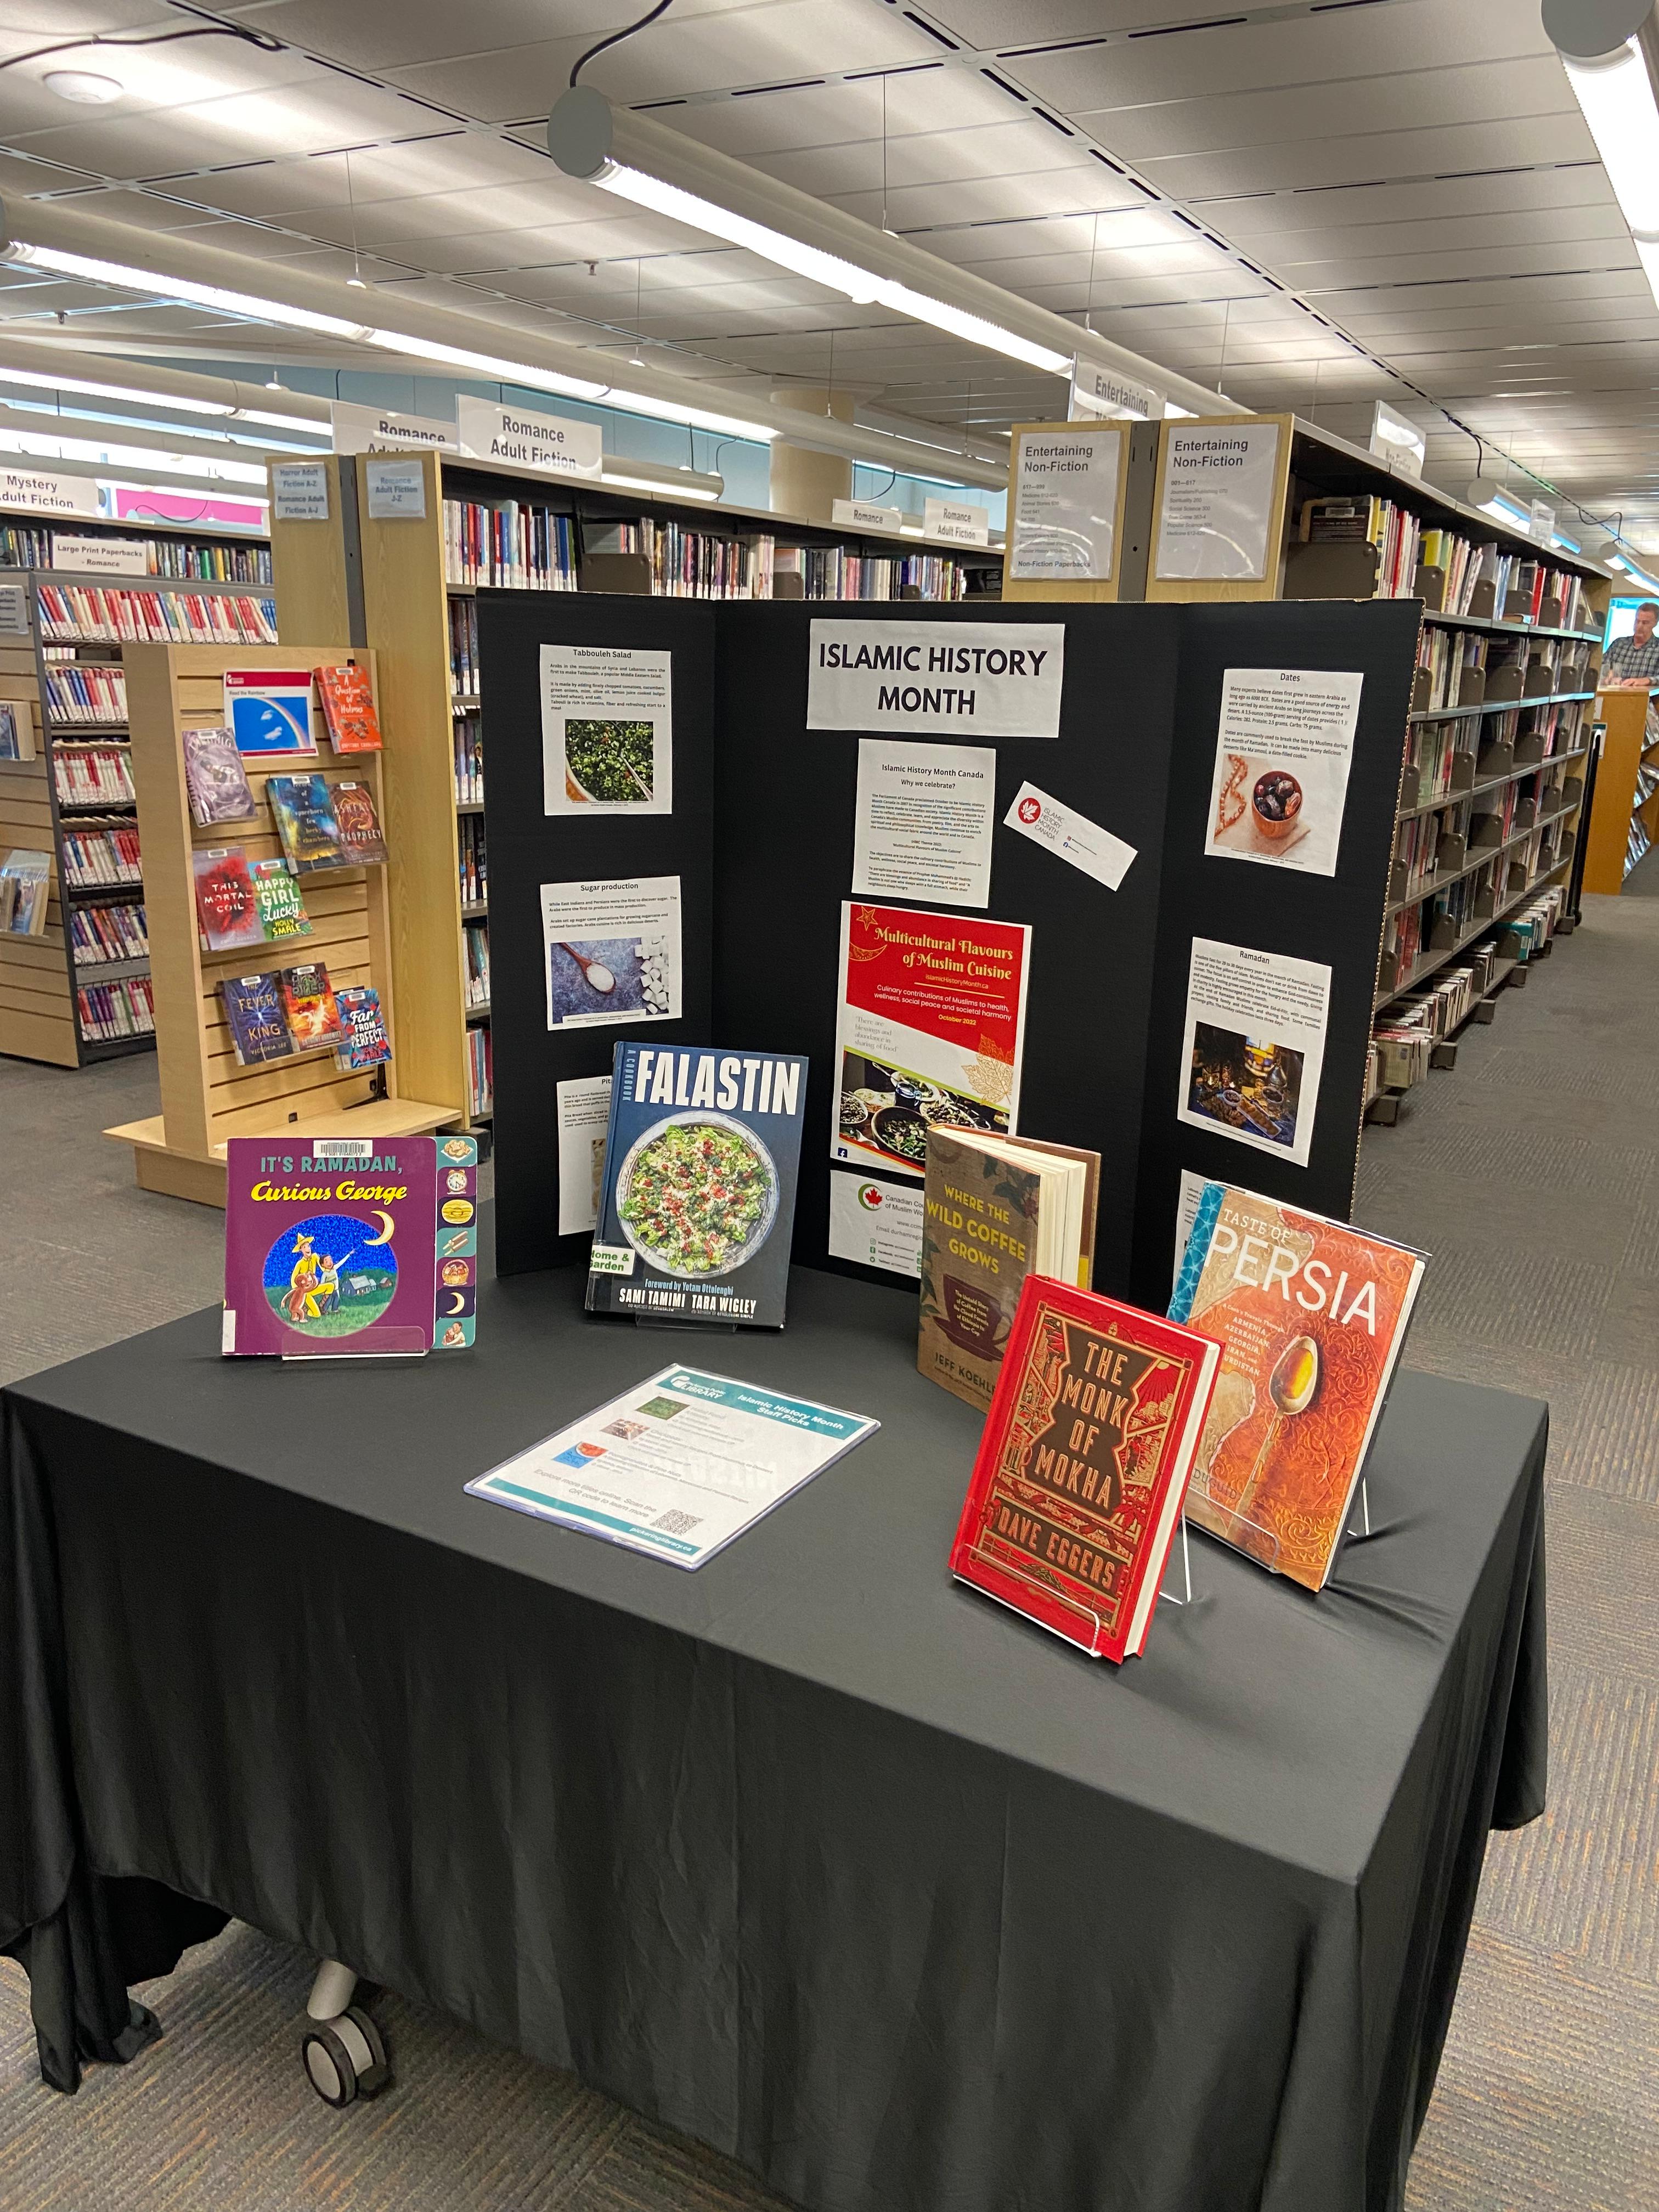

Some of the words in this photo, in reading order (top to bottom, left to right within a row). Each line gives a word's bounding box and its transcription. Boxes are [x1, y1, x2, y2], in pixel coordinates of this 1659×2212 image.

[1096, 374, 1148, 417] Entertaining
[379, 420, 445, 444] Romance
[502, 415, 565, 443] Romance
[490, 439, 527, 460] Adult
[532, 447, 577, 470] Fiction
[1025, 445, 1093, 460] Entertaining
[1174, 439, 1249, 454] Entertaining
[1024, 461, 1089, 472] Non-Fiction
[1173, 456, 1243, 468] Non-Fiction
[7, 475, 58, 493] Mystery
[0, 492, 27, 503] dult
[31, 494, 74, 509] Fiction
[854, 509, 883, 524] Romance
[943, 508, 972, 522] Romance
[938, 524, 953, 537] Adult
[955, 527, 975, 539] Fiction
[58, 544, 79, 553] Large
[81, 546, 99, 555] Print
[101, 549, 143, 557] Paperbacks
[573, 649, 611, 658] Tabbouleh
[820, 643, 921, 672] ISLAMIC
[928, 647, 1048, 676] HISTORY
[1280, 673, 1300, 682] Dates
[335, 685, 360, 695] Question
[878, 686, 975, 715] MONTH
[882, 764, 905, 772] Islamic
[907, 766, 932, 776] History
[958, 770, 984, 778] Canada
[1041, 814, 1062, 829] HISTORY
[1043, 808, 1065, 823] ISLAMIC
[341, 829, 381, 842] PROPHECY
[1035, 825, 1055, 841] CANADA
[1037, 819, 1059, 835] MONTH
[212, 882, 239, 892] THIS
[256, 877, 294, 891] HAPPY
[601, 883, 638, 892] production
[204, 892, 252, 904] MORTAL
[261, 888, 300, 905] GIRL
[217, 904, 244, 913] COIL
[263, 902, 300, 922] Lucky
[272, 924, 301, 936] SMALE
[874, 927, 956, 952] Multicultural
[958, 940, 1013, 960] Flavours
[902, 953, 915, 967] of
[916, 952, 964, 973] Muslim
[967, 962, 1012, 980] Cuisine
[1239, 951, 1269, 964] Ramadan
[238, 994, 274, 1012] FEVER
[874, 992, 901, 1003] wellness,
[901, 996, 920, 1005] social
[921, 1000, 941, 1010] peace
[942, 1002, 955, 1011] and
[956, 1006, 980, 1015] societal
[981, 1009, 1012, 1022] harmony
[877, 984, 902, 996] Culinary
[903, 989, 944, 1001] contributions
[952, 996, 978, 1007] Muslims
[987, 1002, 1009, 1013] health,
[350, 1010, 374, 1025] Far
[354, 1020, 376, 1032] FROM
[938, 1014, 962, 1023] October
[248, 1023, 281, 1041] KING
[351, 1028, 383, 1048] PERFECT
[622, 1058, 635, 1102] COOKBOOK
[634, 1050, 800, 1116] FALASTIN
[261, 1156, 294, 1173] IT'S
[301, 1155, 403, 1174] RAMADAN,
[250, 1181, 331, 1202] Curious
[335, 1181, 407, 1205] George
[885, 1195, 912, 1205] Canadian
[892, 1204, 912, 1214] Muslim
[944, 1184, 984, 1213] WHERE
[988, 1203, 1009, 1225] THE
[926, 1198, 963, 1229] WILD
[967, 1219, 1026, 1262] COFFEE
[1222, 1209, 1268, 1234] TASTE
[1270, 1226, 1291, 1244] OF
[621, 1254, 629, 1262] &
[949, 1238, 999, 1274] GROWS
[645, 1278, 673, 1290] Foreword
[674, 1281, 681, 1292] by
[682, 1282, 701, 1293] Yotam
[702, 1283, 734, 1296] Ottolenghi
[1204, 1223, 1377, 1336] PERSIA
[619, 1288, 646, 1304] SAMI
[648, 1290, 686, 1308] TAMIMI
[692, 1295, 716, 1311] TARA
[719, 1297, 757, 1314] WIGLEY
[1086, 1341, 1128, 1386] THE
[1223, 1355, 1260, 1376] URDISTAN
[680, 1384, 724, 1400] LIBRARY
[1061, 1374, 1129, 1428] MONK
[737, 1395, 773, 1408] Islamic
[774, 1404, 811, 1419] History
[811, 1416, 843, 1430] Month
[757, 1407, 781, 1419] Staff
[782, 1414, 810, 1426] Picks
[1068, 1419, 1099, 1456] OF
[1037, 1444, 1113, 1509] MOKHA
[1193, 1468, 1237, 1499] DUGUID
[534, 1469, 562, 1481] Explore
[562, 1477, 581, 1487] more
[581, 1481, 599, 1493] titles
[624, 1498, 644, 1509] Scan
[644, 1503, 657, 1513] the
[629, 1527, 692, 1554] pickeringlibrary.ca
[997, 1505, 1042, 1549] DAVE
[1045, 1532, 1114, 1589] EGGERS
